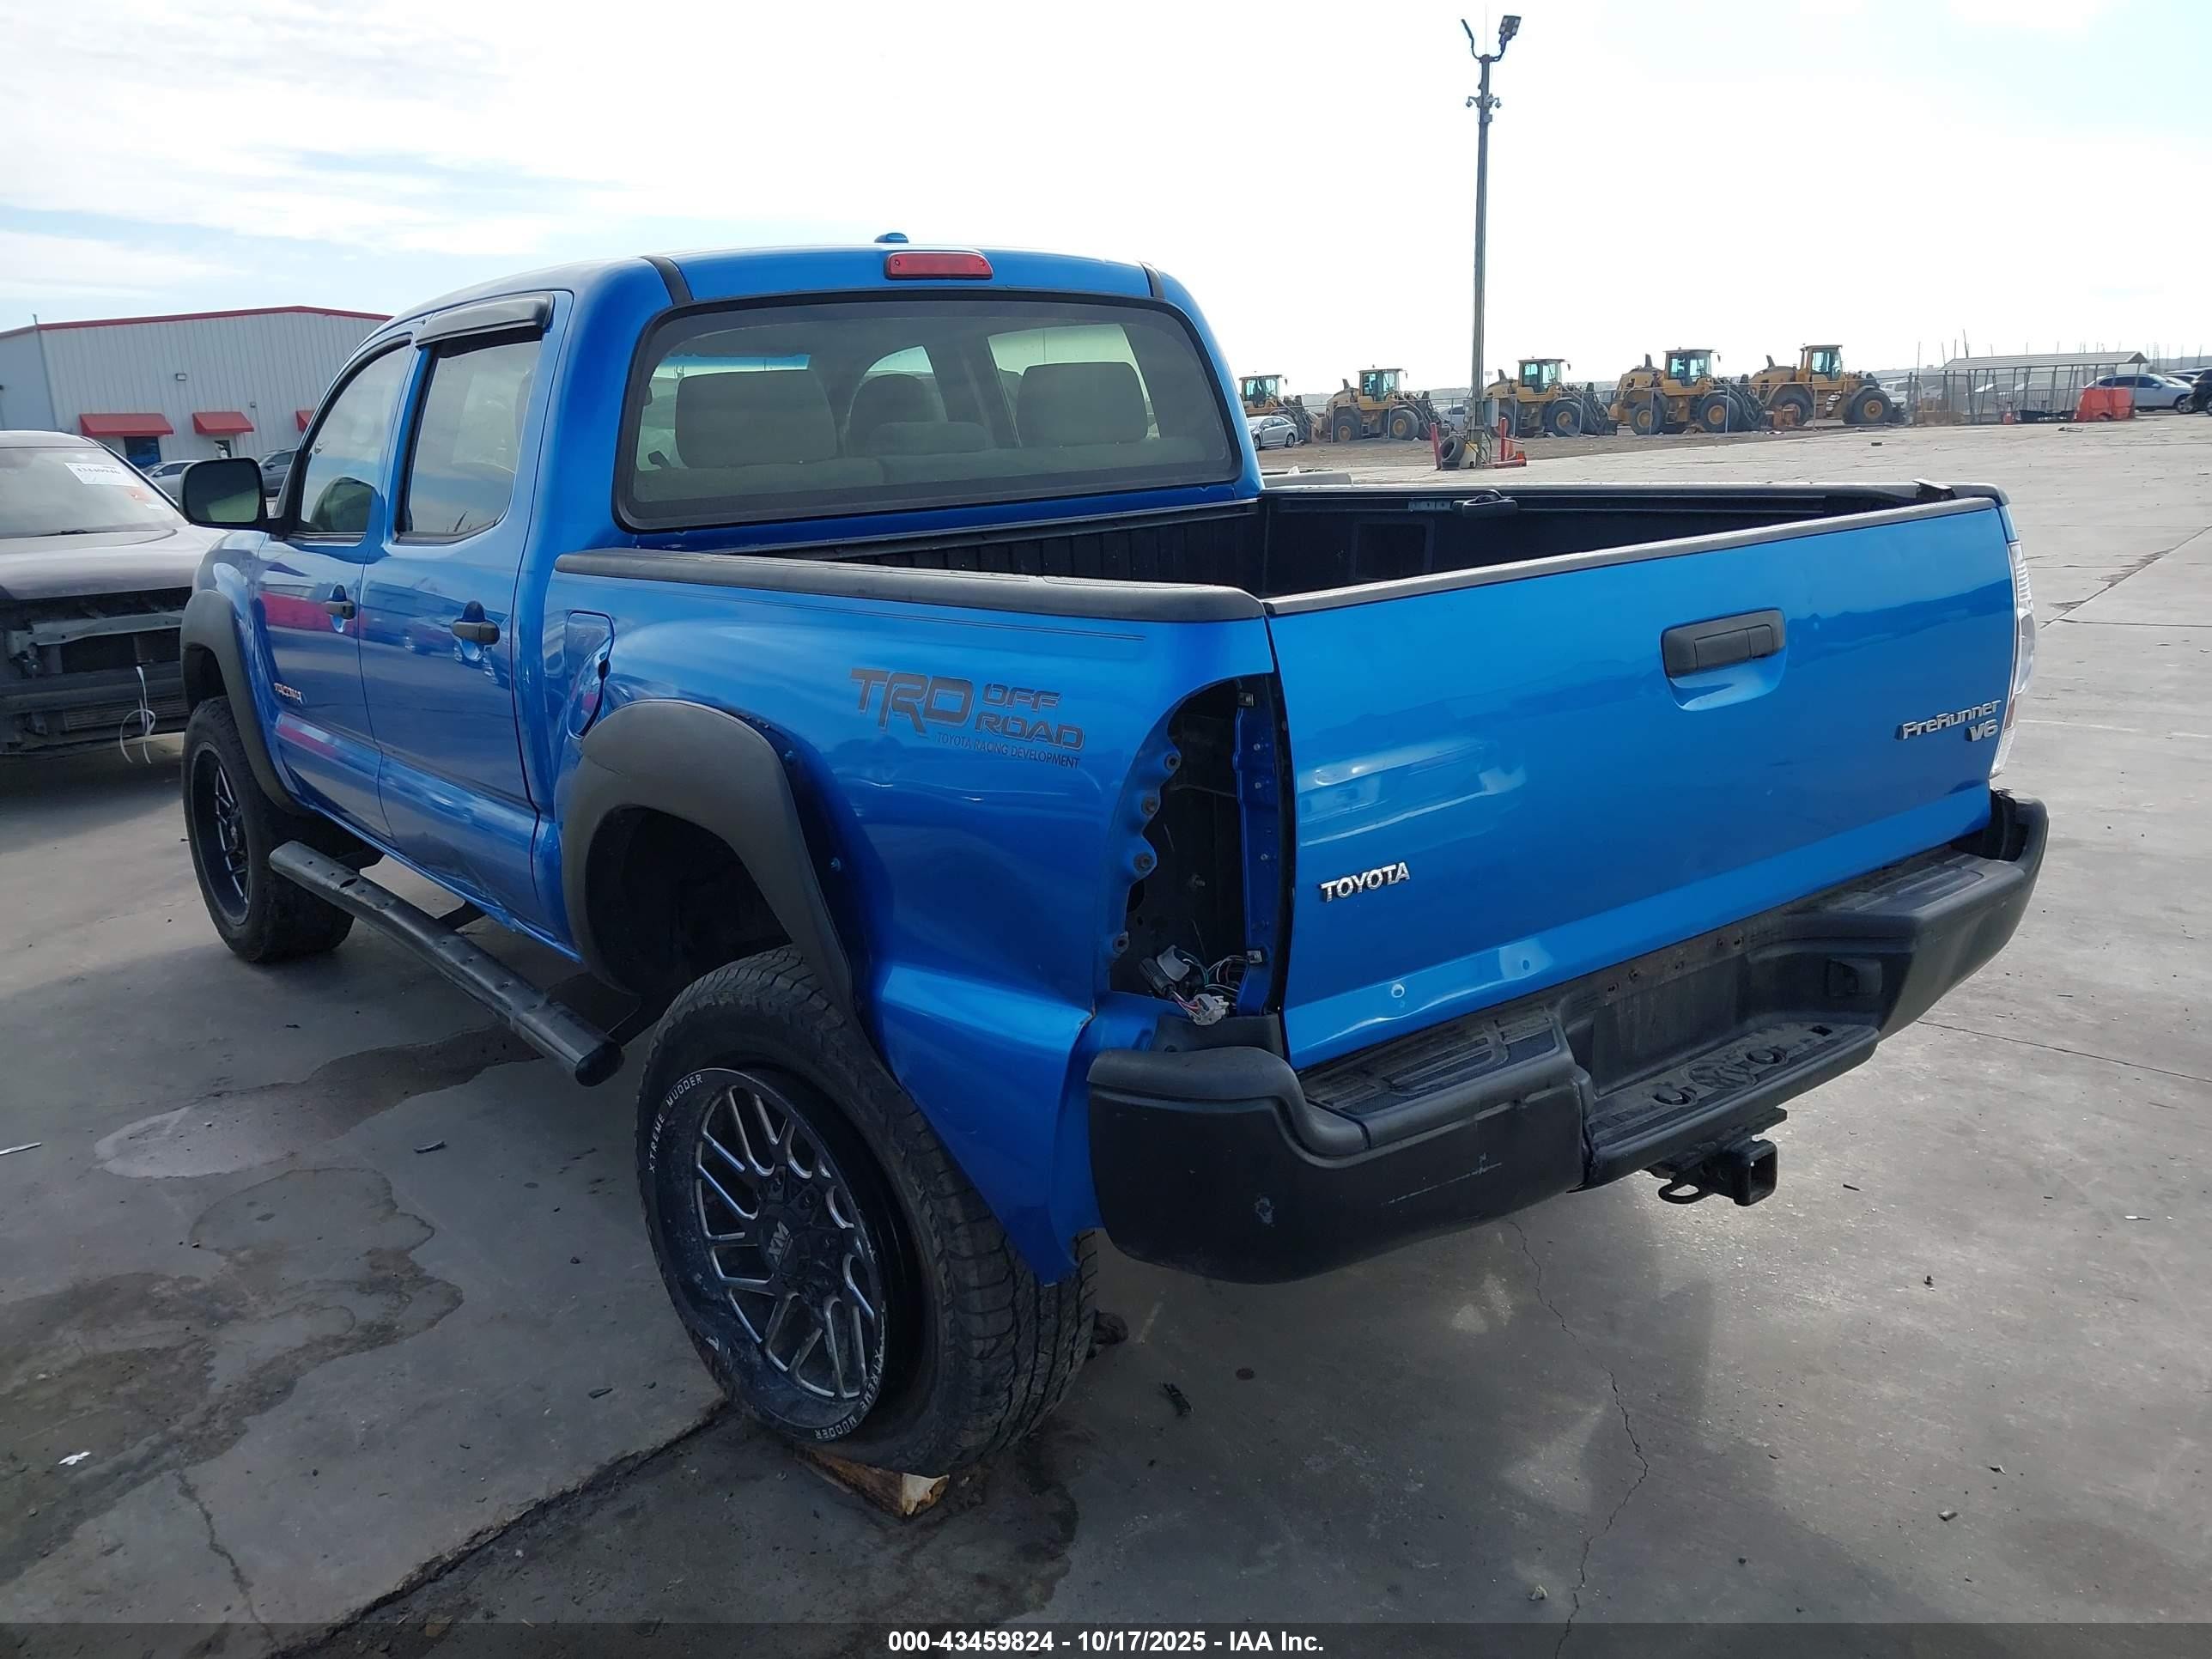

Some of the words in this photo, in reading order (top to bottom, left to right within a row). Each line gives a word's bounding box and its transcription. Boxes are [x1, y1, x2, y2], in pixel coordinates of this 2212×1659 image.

[851, 667, 974, 734] TRD
[982, 684, 1060, 712] OFF
[975, 711, 1085, 751] ROAD
[1901, 699, 2002, 740] PreRunner
[1969, 719, 1998, 741] V6
[938, 732, 972, 750] TOYOTA
[974, 740, 1008, 757] RACING
[1011, 746, 1079, 769] DEVELOPMENT
[1320, 861, 1411, 903] TOYOTA
